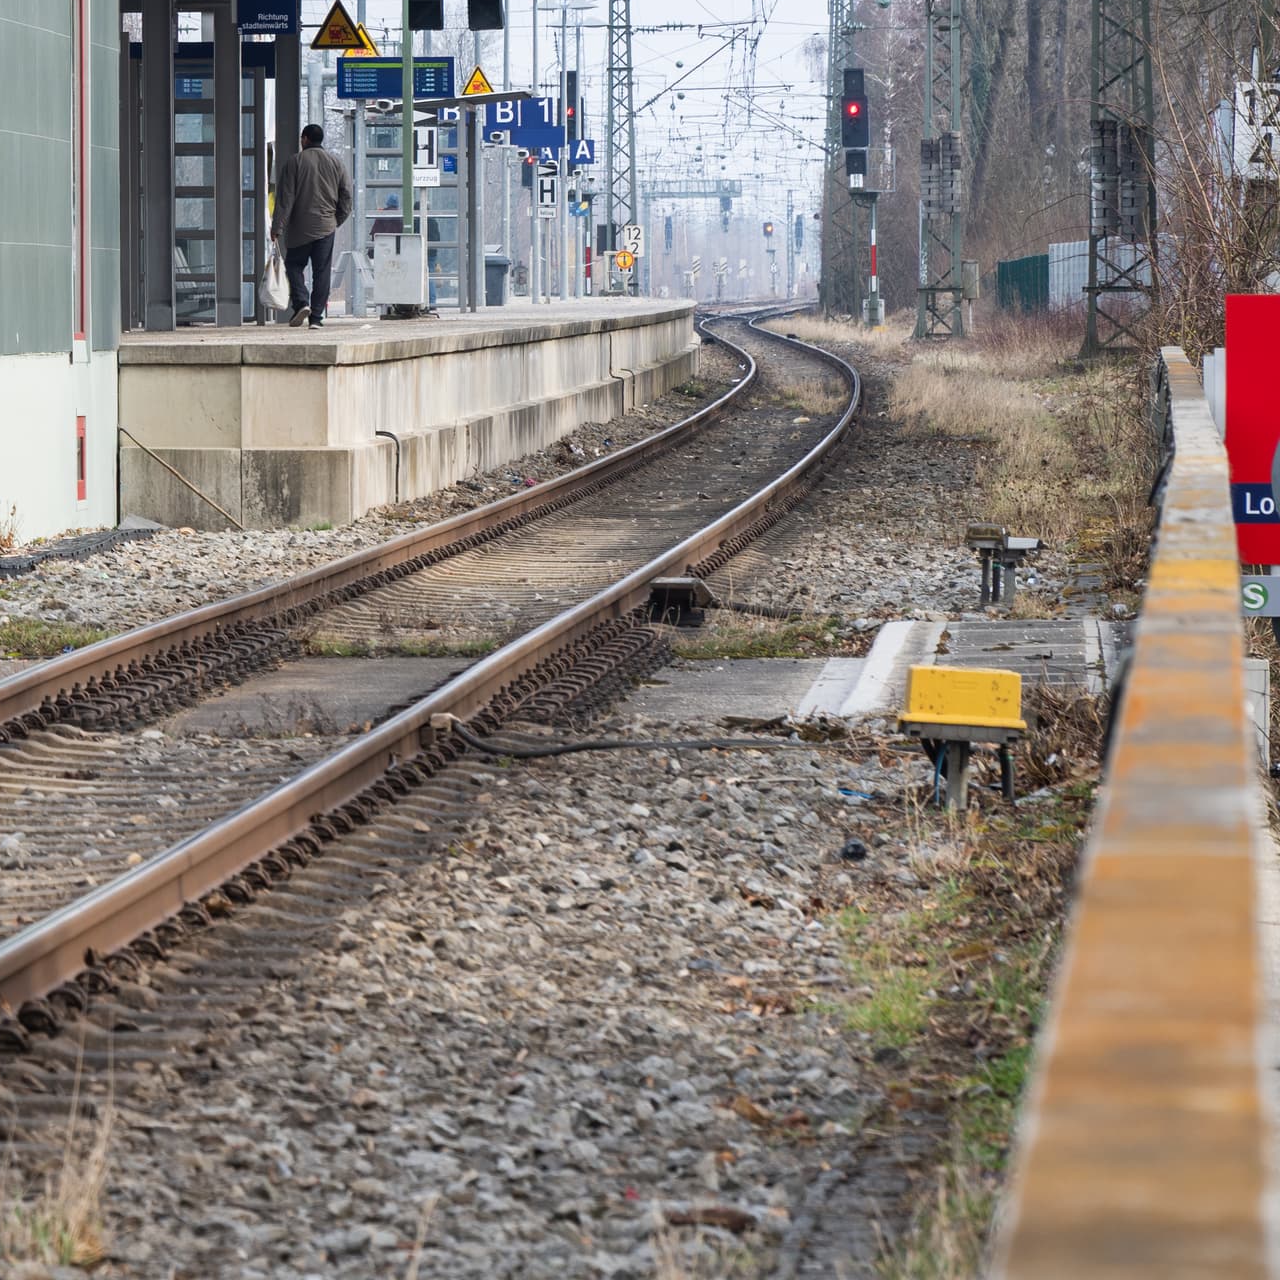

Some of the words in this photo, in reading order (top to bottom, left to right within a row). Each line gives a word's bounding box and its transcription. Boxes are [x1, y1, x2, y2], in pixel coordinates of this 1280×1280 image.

[257, 13, 289, 22] Richtung
[242, 22, 289, 30] stadteinwärts
[496, 100, 514, 123] B
[538, 98, 550, 123] 1
[576, 140, 591, 159] A
[413, 174, 438, 184] urzzug
[539, 179, 556, 204] H
[627, 226, 642, 241] 12
[630, 241, 640, 255] 2
[1243, 583, 1265, 609] S
